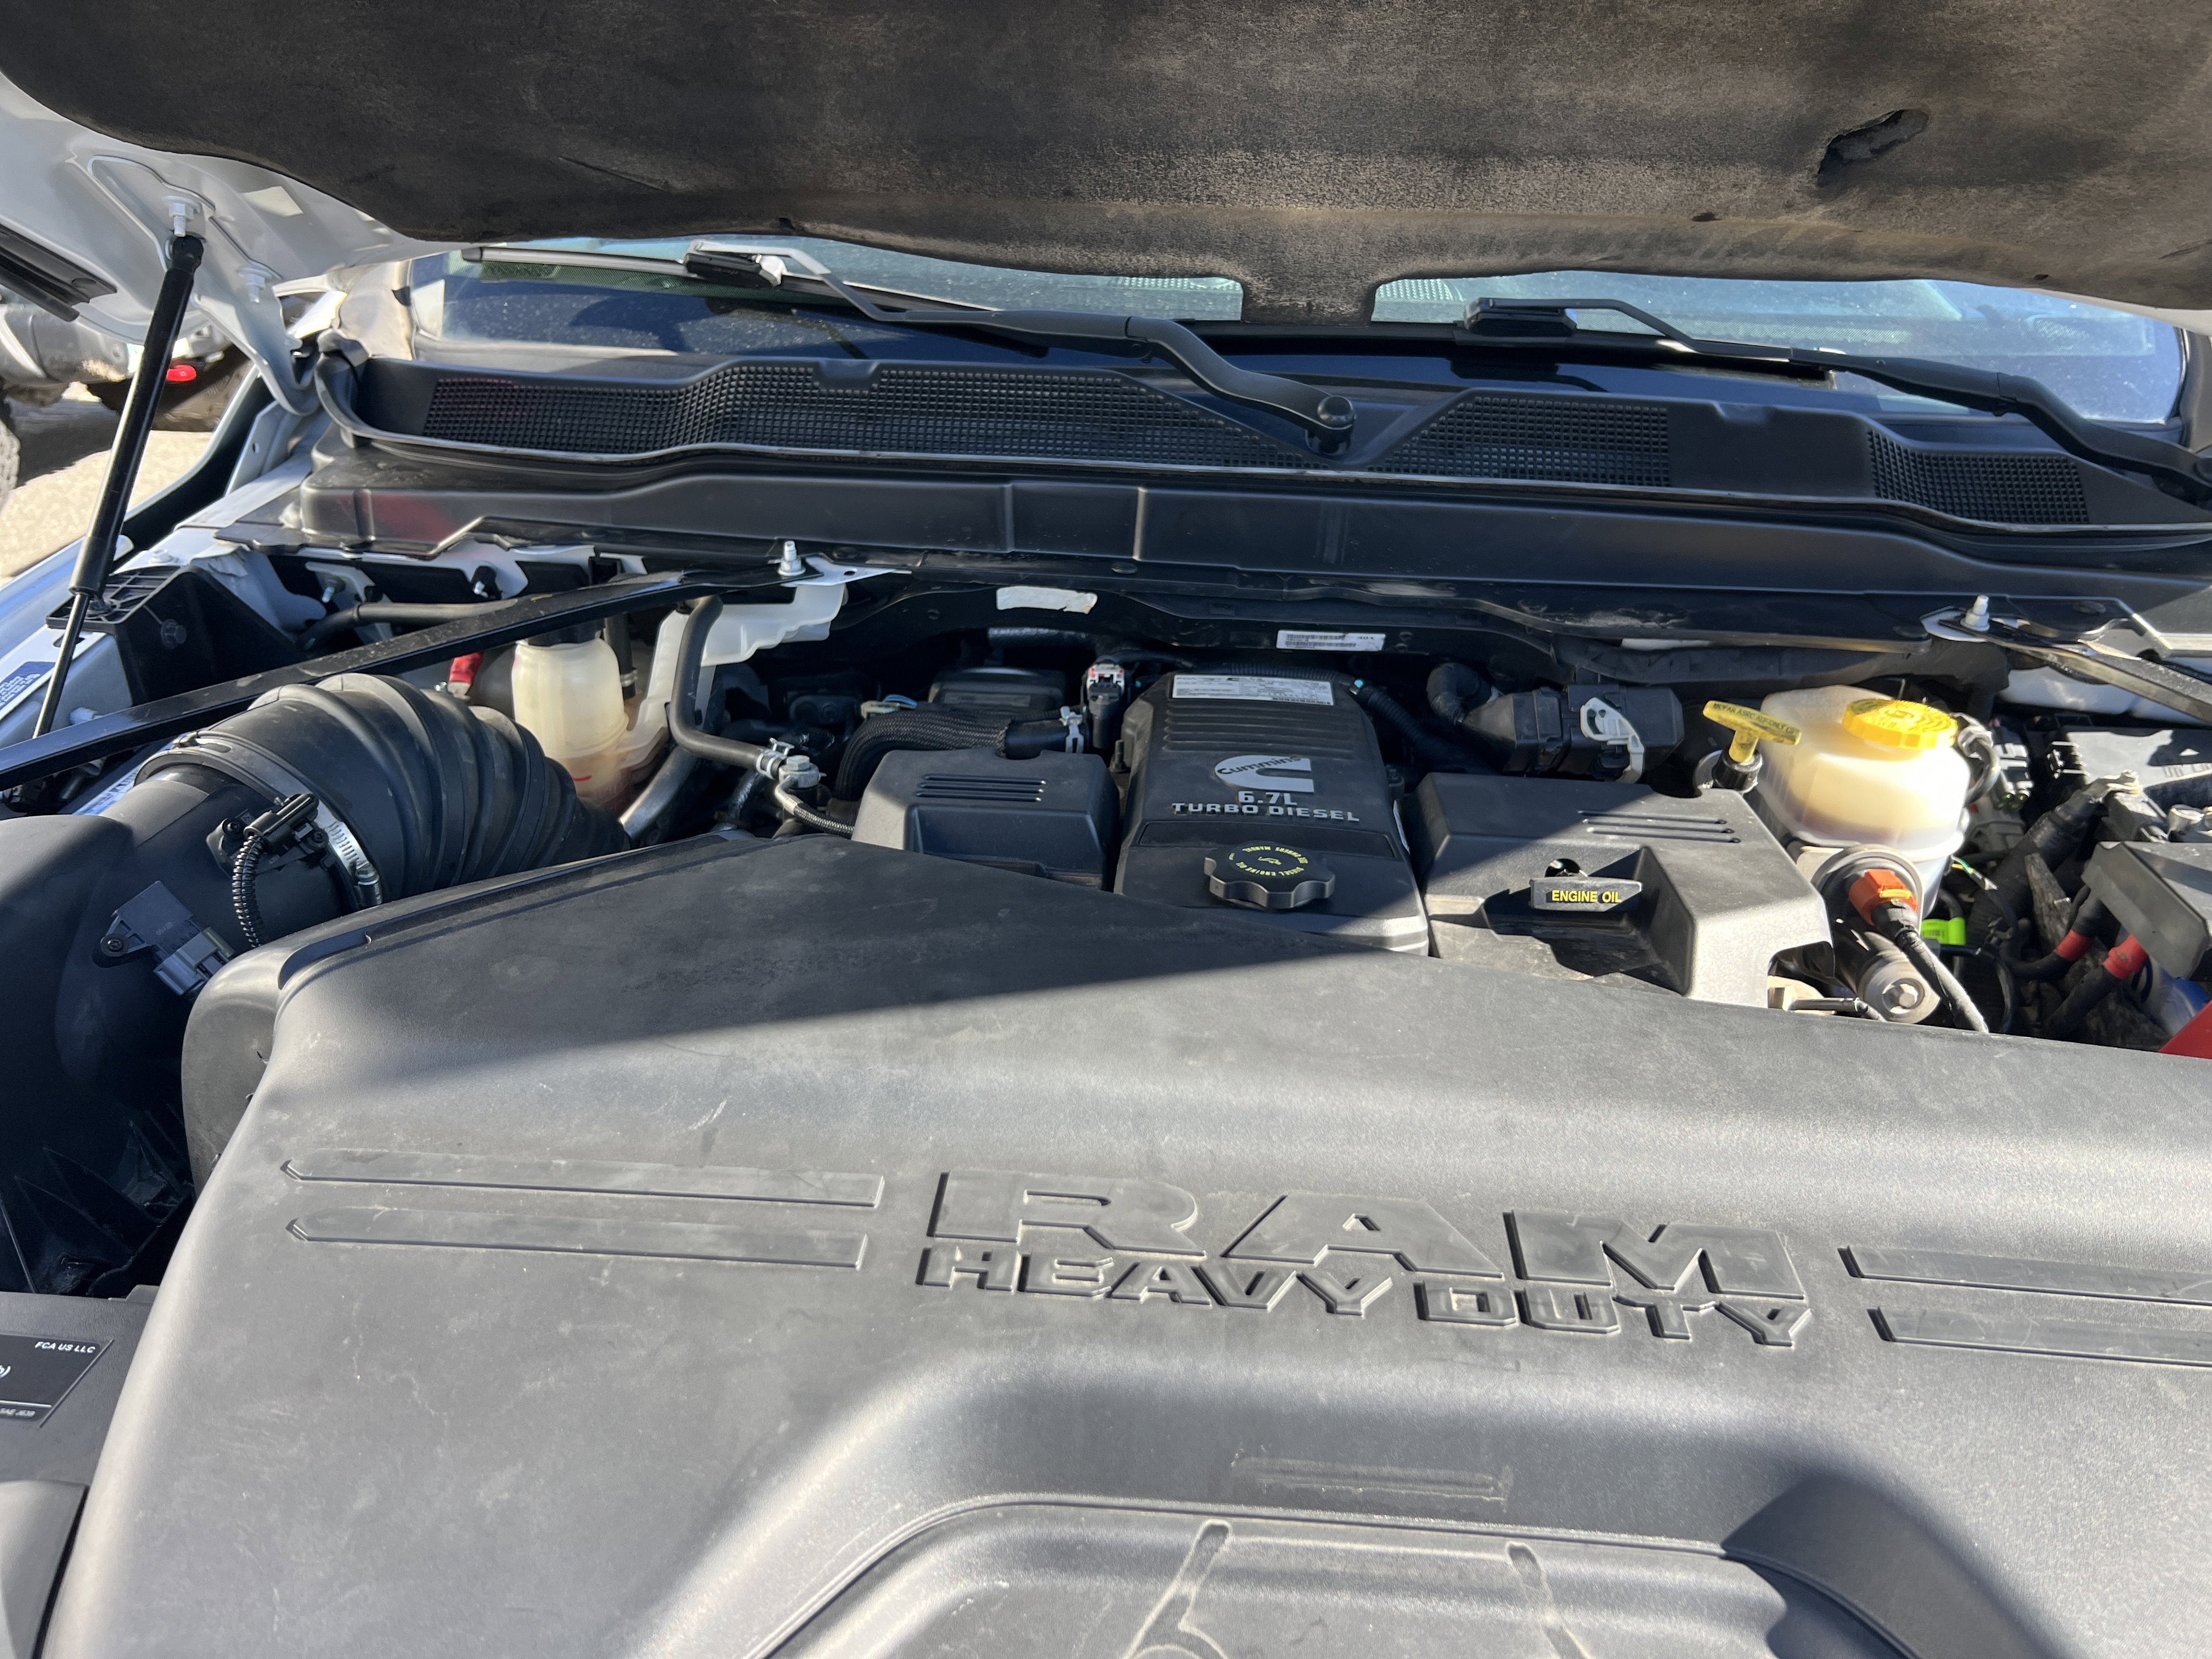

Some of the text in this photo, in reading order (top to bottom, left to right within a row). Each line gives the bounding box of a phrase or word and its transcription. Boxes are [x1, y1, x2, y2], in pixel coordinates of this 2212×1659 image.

[1217, 757, 1301, 775] Cummins
[1238, 791, 1297, 806] 6.7L
[1172, 803, 1360, 822] TURBO DIESEL
[1551, 890, 1622, 903] ENGINE OIL
[926, 1170, 1809, 1301] RAM
[915, 1245, 1813, 1348] HEAVY DUTY
[34, 1341, 96, 1354] FCA US LLC
